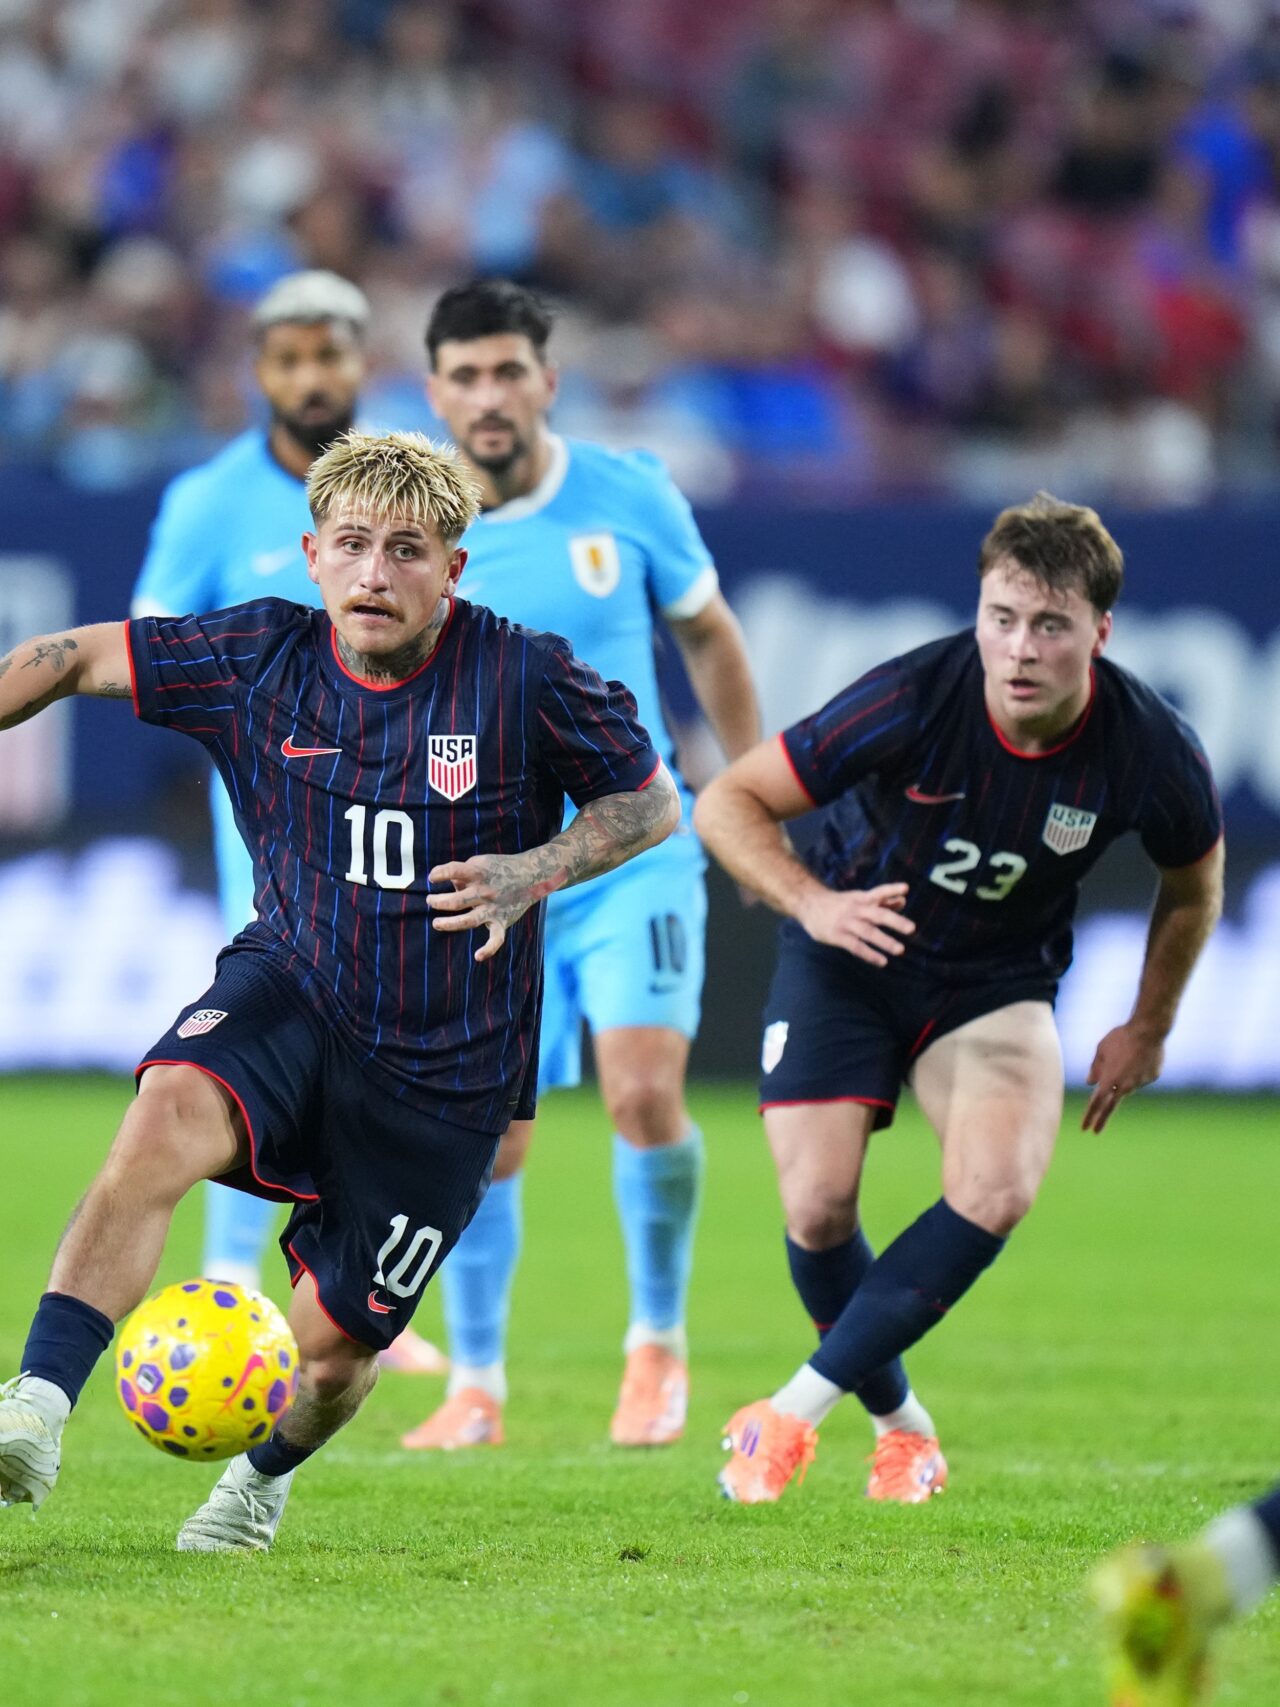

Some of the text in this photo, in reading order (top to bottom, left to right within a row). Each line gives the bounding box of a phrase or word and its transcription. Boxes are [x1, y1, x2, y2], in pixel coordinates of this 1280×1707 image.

[431, 739, 473, 763] USA
[1053, 808, 1091, 828] USA
[344, 804, 415, 889] 10
[929, 838, 1028, 900] 23
[192, 1010, 225, 1022] USA
[372, 1213, 443, 1298] 10
